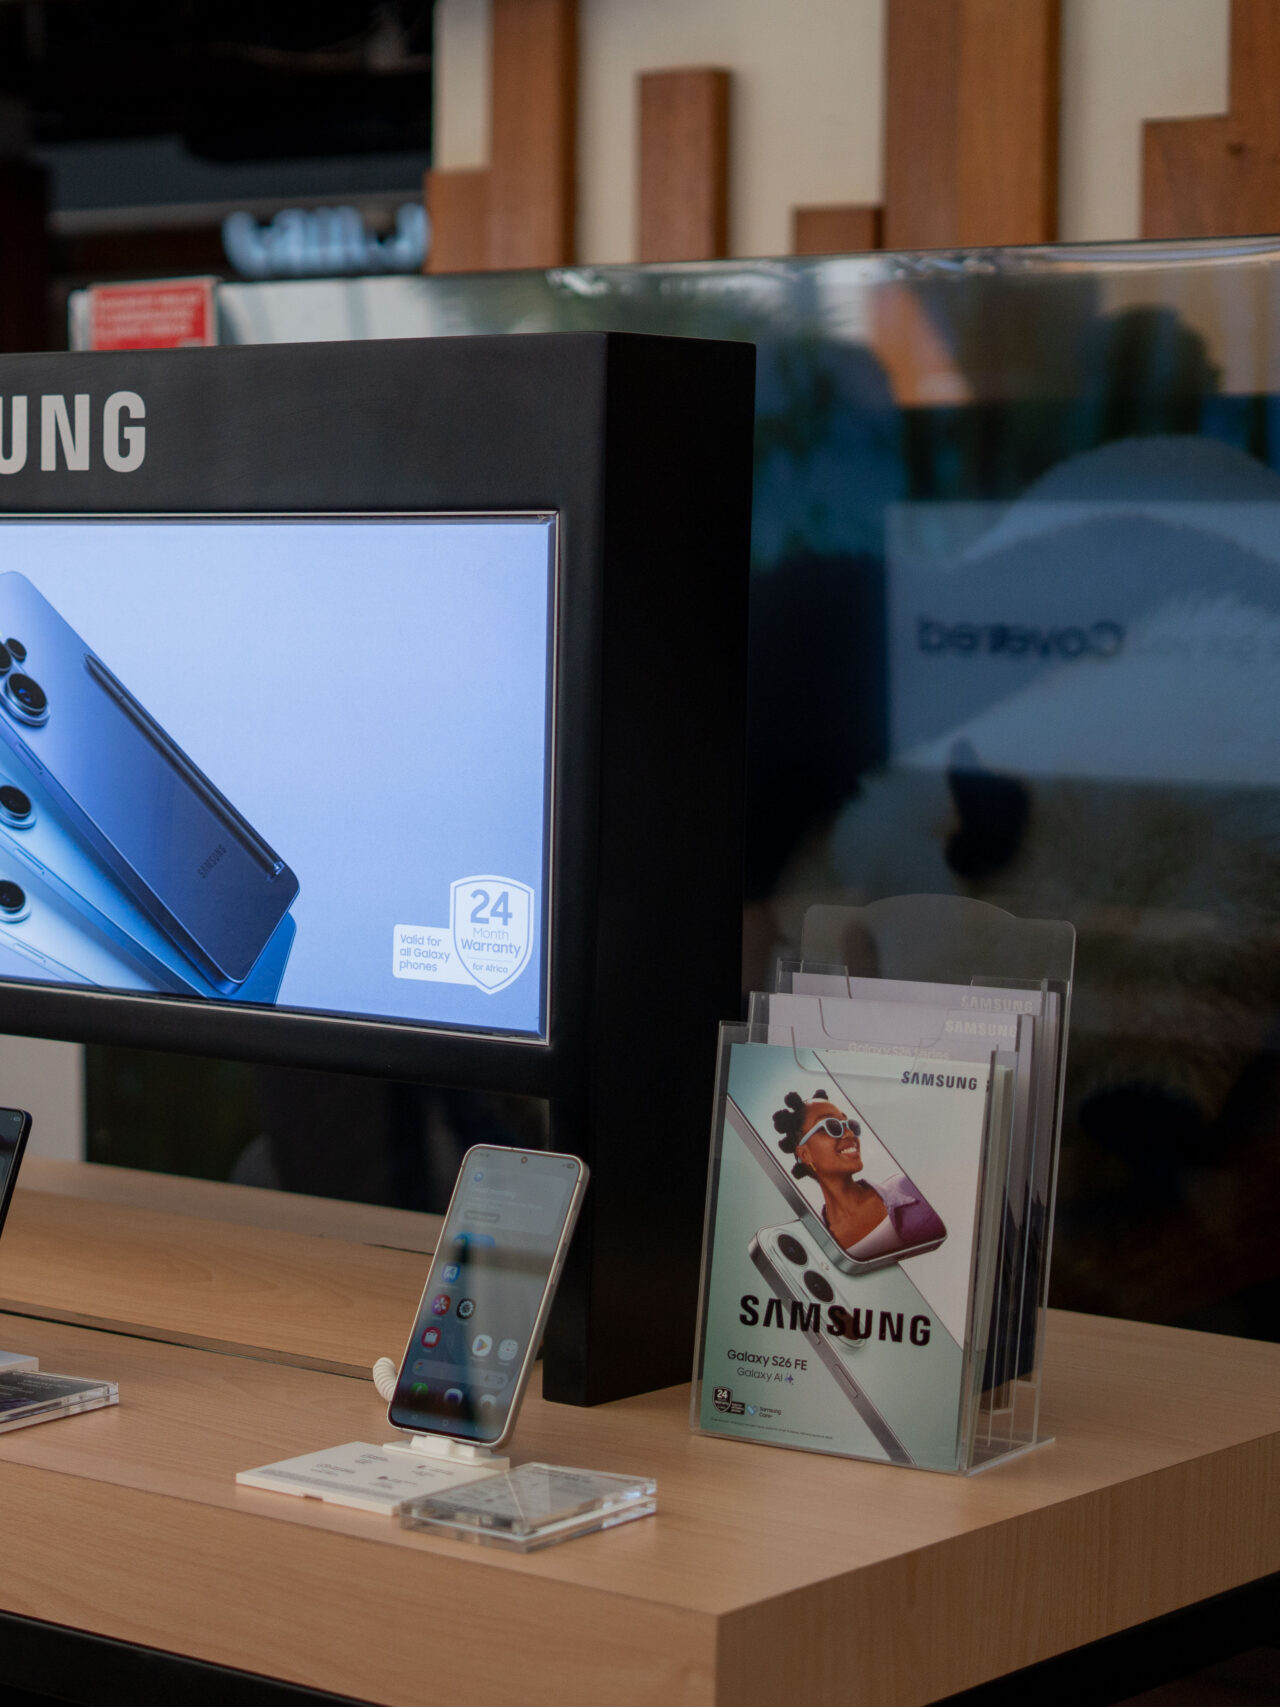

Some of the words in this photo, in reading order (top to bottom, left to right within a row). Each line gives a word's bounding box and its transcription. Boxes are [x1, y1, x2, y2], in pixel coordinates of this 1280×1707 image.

[470, 889, 513, 926] 24
[400, 934, 425, 946] Valid
[427, 936, 442, 947] for
[472, 927, 510, 940] Month
[400, 947, 412, 957] all
[414, 948, 451, 963] Galaxy
[460, 938, 522, 959] Warranty
[399, 960, 438, 972] phones
[472, 962, 484, 971] for
[486, 964, 509, 974] Africa
[961, 995, 1033, 1014] SAMSUNG
[945, 1020, 1017, 1038] SAMSUNG
[901, 1071, 977, 1090] SAMSUNG
[739, 1294, 932, 1346] SAMSUNG
[727, 1349, 770, 1368] Galaxy
[771, 1355, 792, 1368] S26
[794, 1359, 808, 1371] FE
[736, 1367, 773, 1383] Galaxy
[774, 1373, 783, 1382] AI
[716, 1389, 728, 1399] 24
